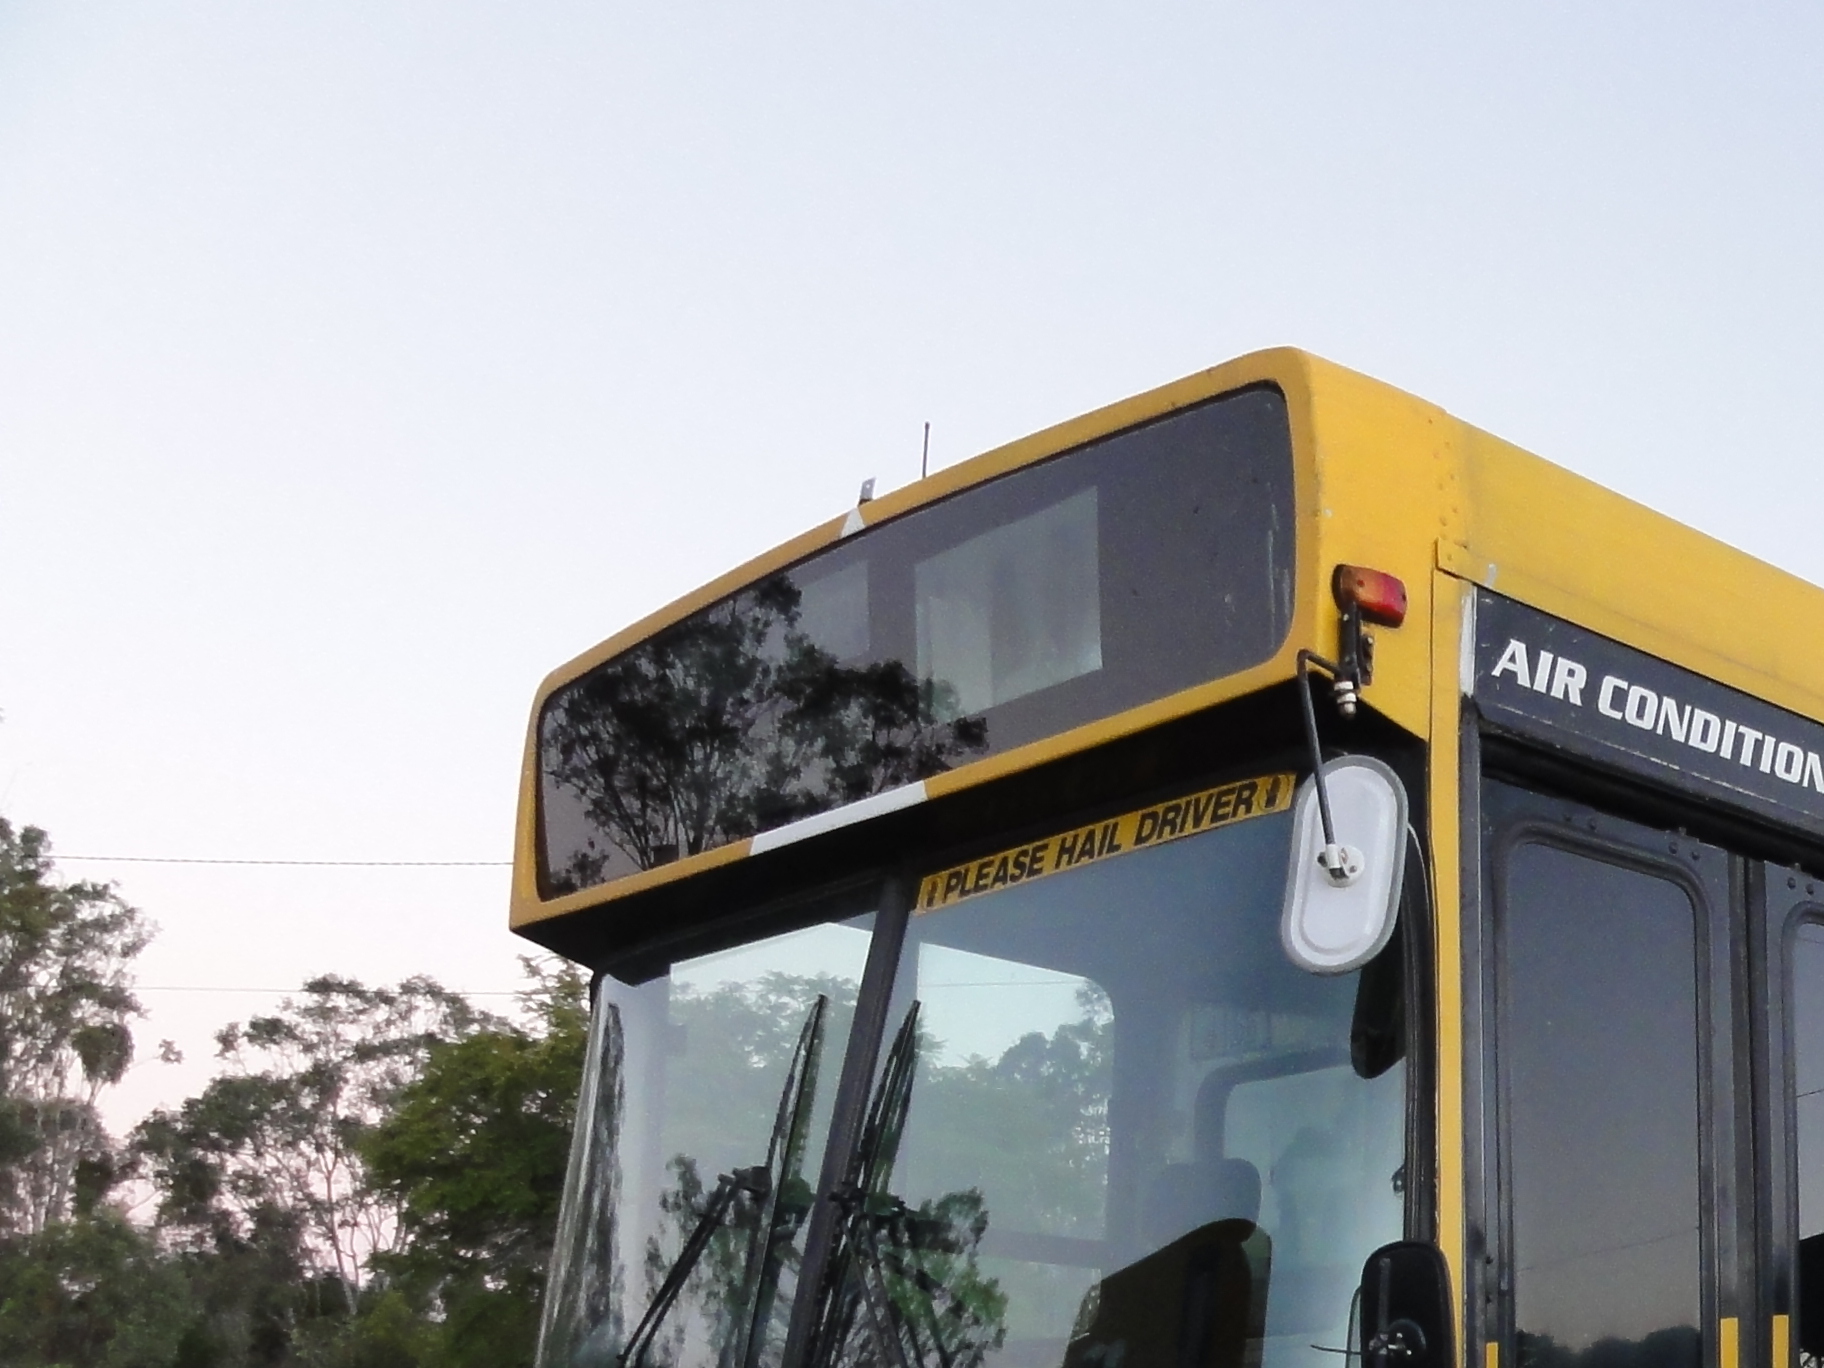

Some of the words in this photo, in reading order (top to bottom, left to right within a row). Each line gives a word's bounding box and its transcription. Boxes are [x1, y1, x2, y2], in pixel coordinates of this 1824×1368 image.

[1491, 639, 1587, 706] AIR
[942, 844, 1049, 904] PLEASE
[1054, 822, 1122, 870] HAIL
[1134, 781, 1258, 846] DRIVER
